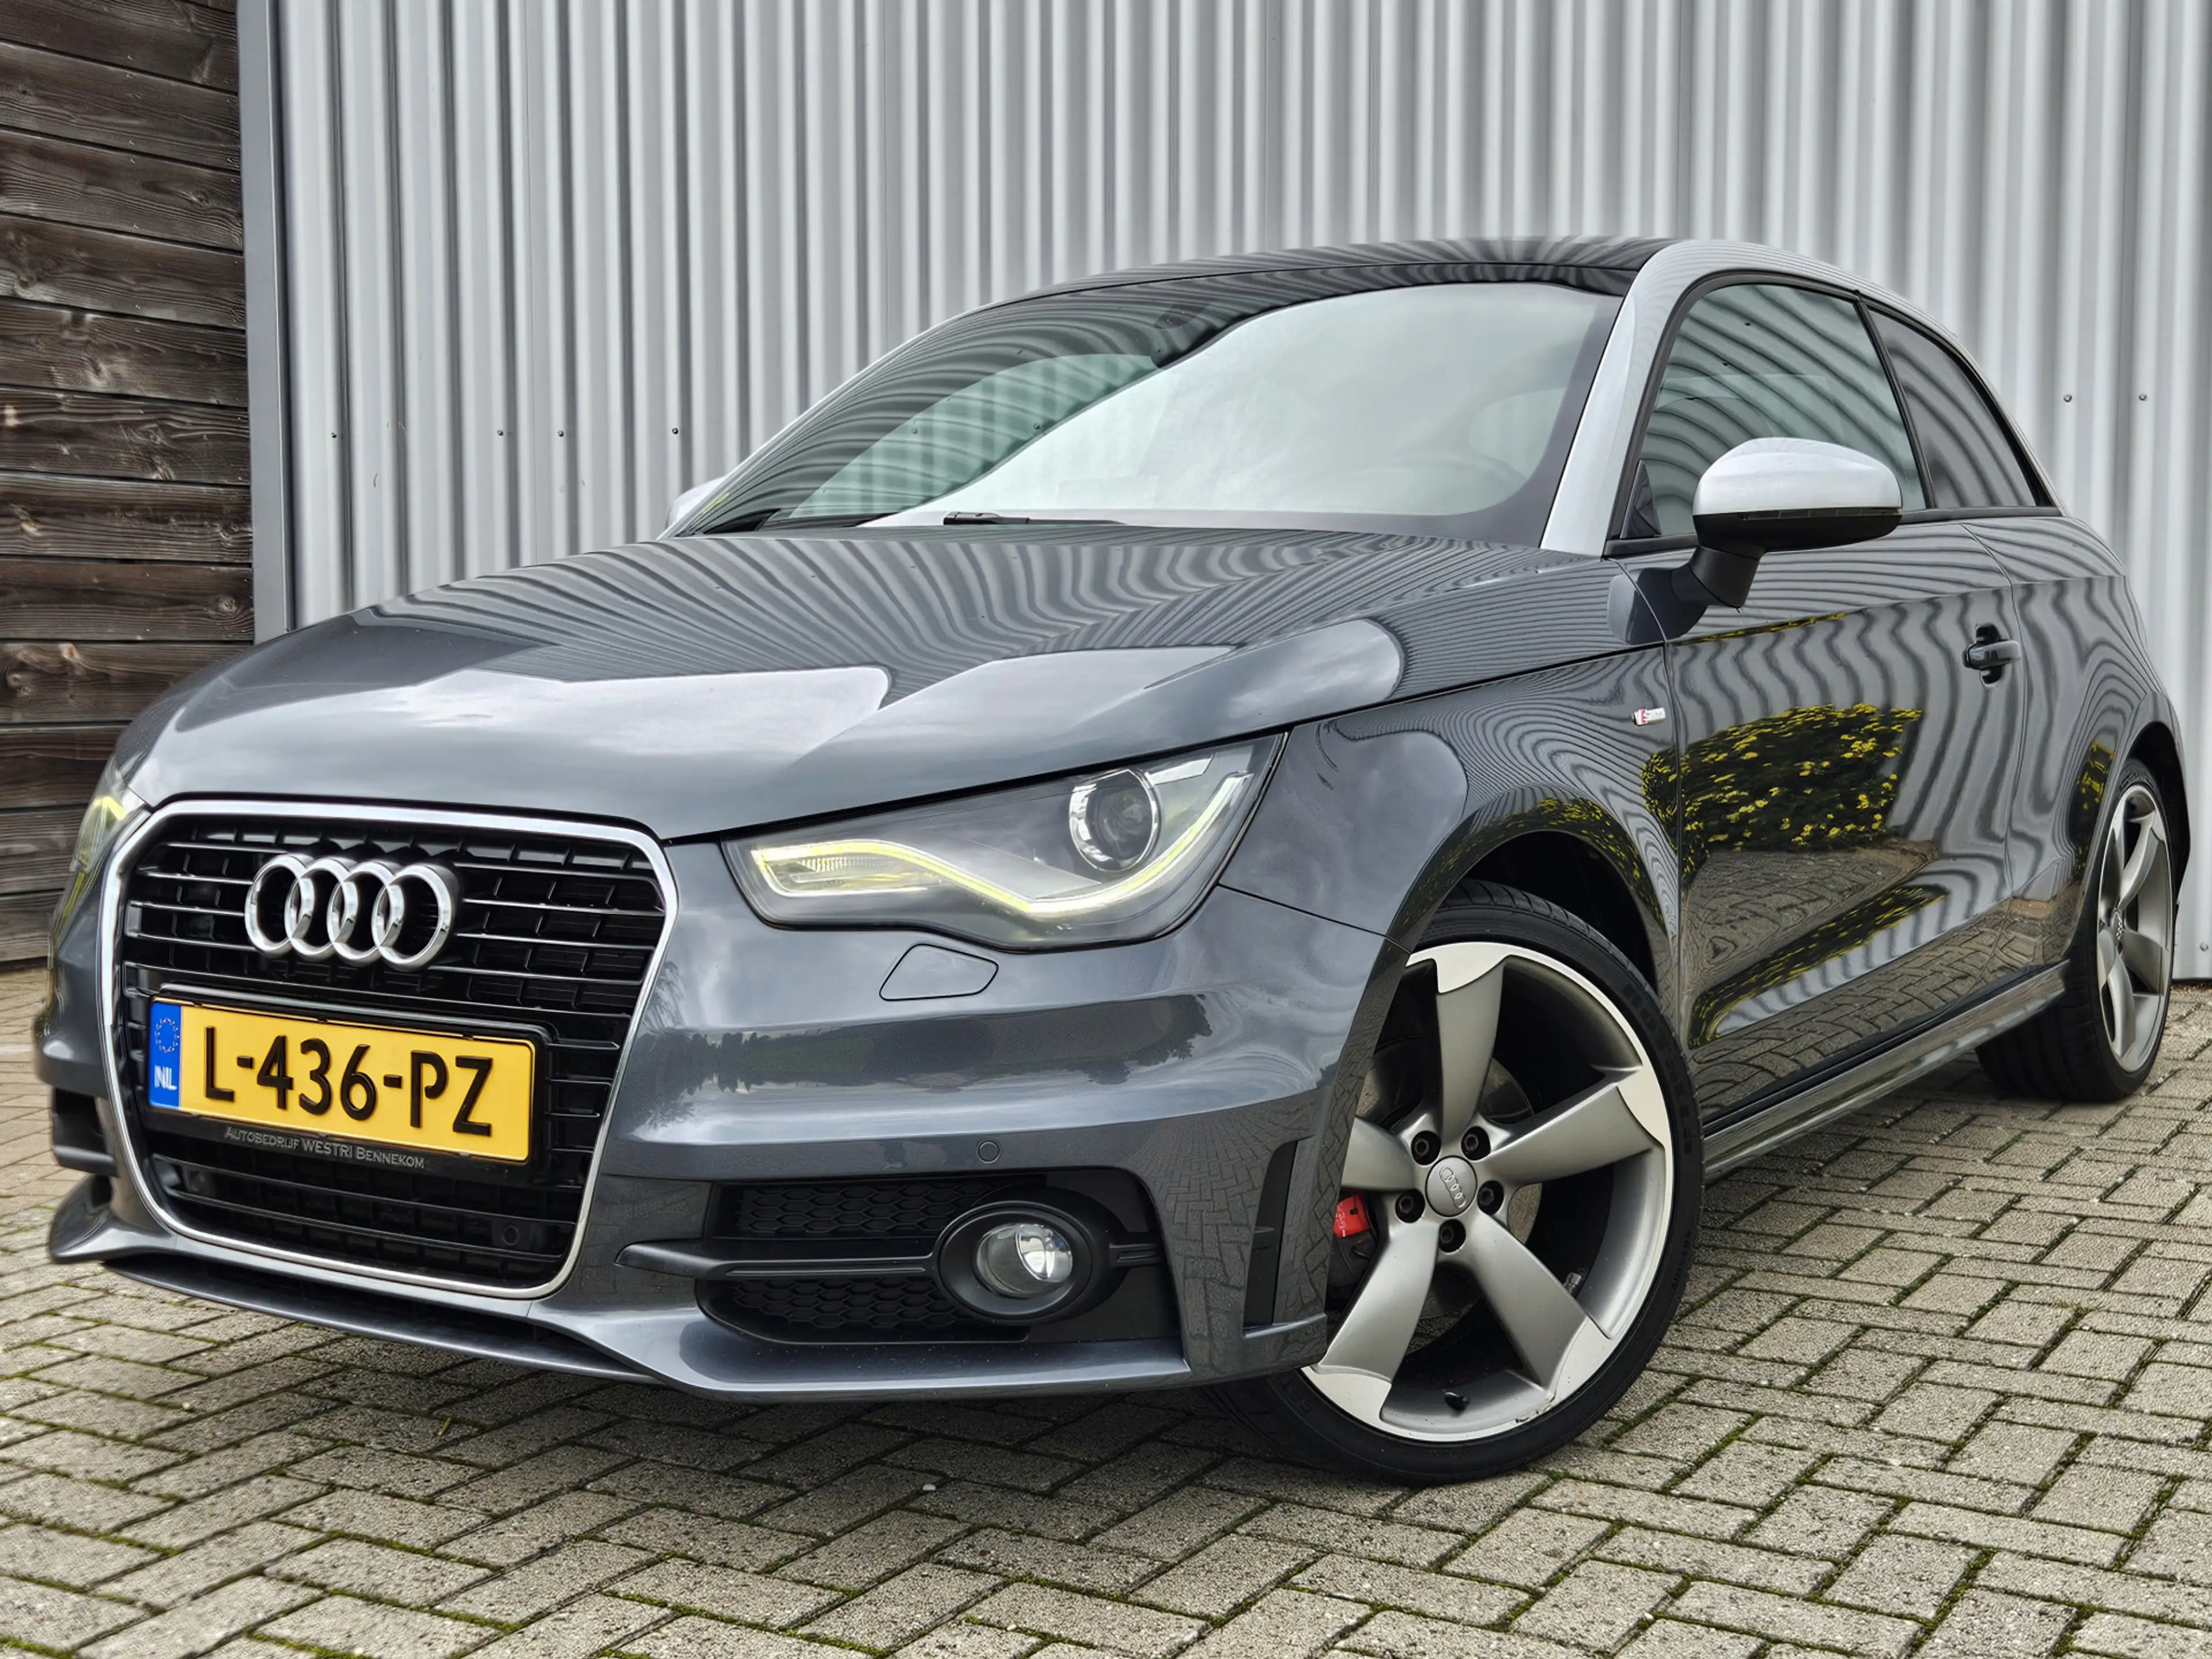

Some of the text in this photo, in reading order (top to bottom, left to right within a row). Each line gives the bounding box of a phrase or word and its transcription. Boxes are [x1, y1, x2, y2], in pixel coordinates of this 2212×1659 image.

[154, 1065, 177, 1090] NL
[204, 1025, 493, 1138] L-436-PZ
[224, 1126, 425, 1169] AUTOBEDRIJF WESTRI BENNEKOM
